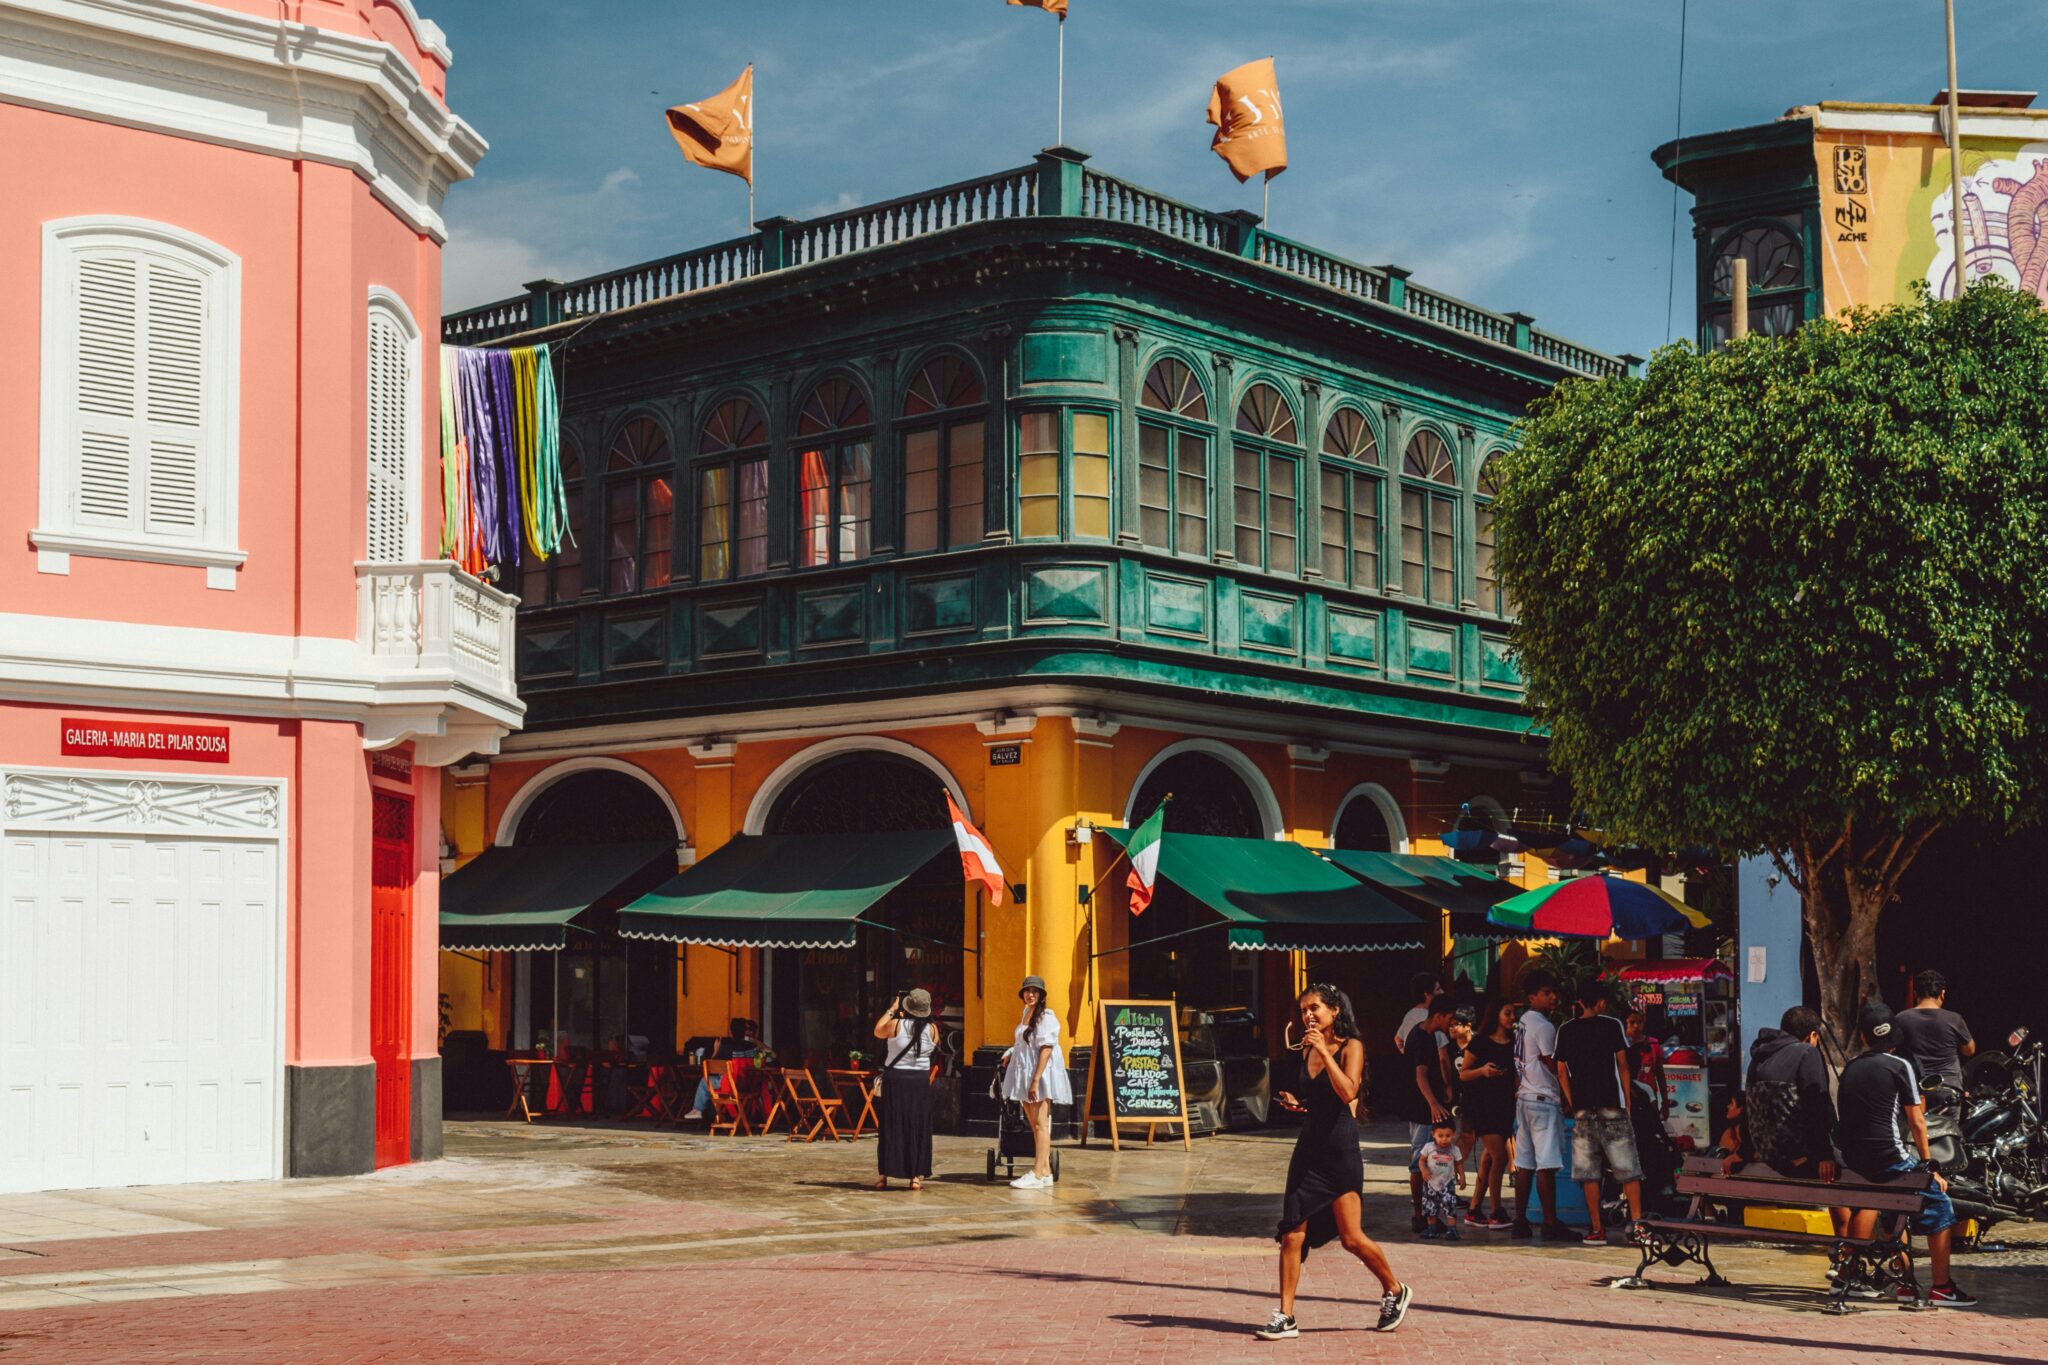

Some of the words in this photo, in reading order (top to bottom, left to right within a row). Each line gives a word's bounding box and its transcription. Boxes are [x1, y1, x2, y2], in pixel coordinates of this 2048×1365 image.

[1837, 232, 1868, 242] ACHE
[148, 732, 166, 749] DEL
[168, 733, 194, 751] PILAR
[195, 735, 227, 753] SOUSA
[1130, 1038, 1162, 1048] Dulces
[1162, 1036, 1170, 1047] &
[1122, 1056, 1160, 1070] PASTAS
[1127, 1070, 1168, 1079] HELADOS
[1119, 1087, 1146, 1099] Jugos
[1126, 1098, 1175, 1109] CERVEZAS
